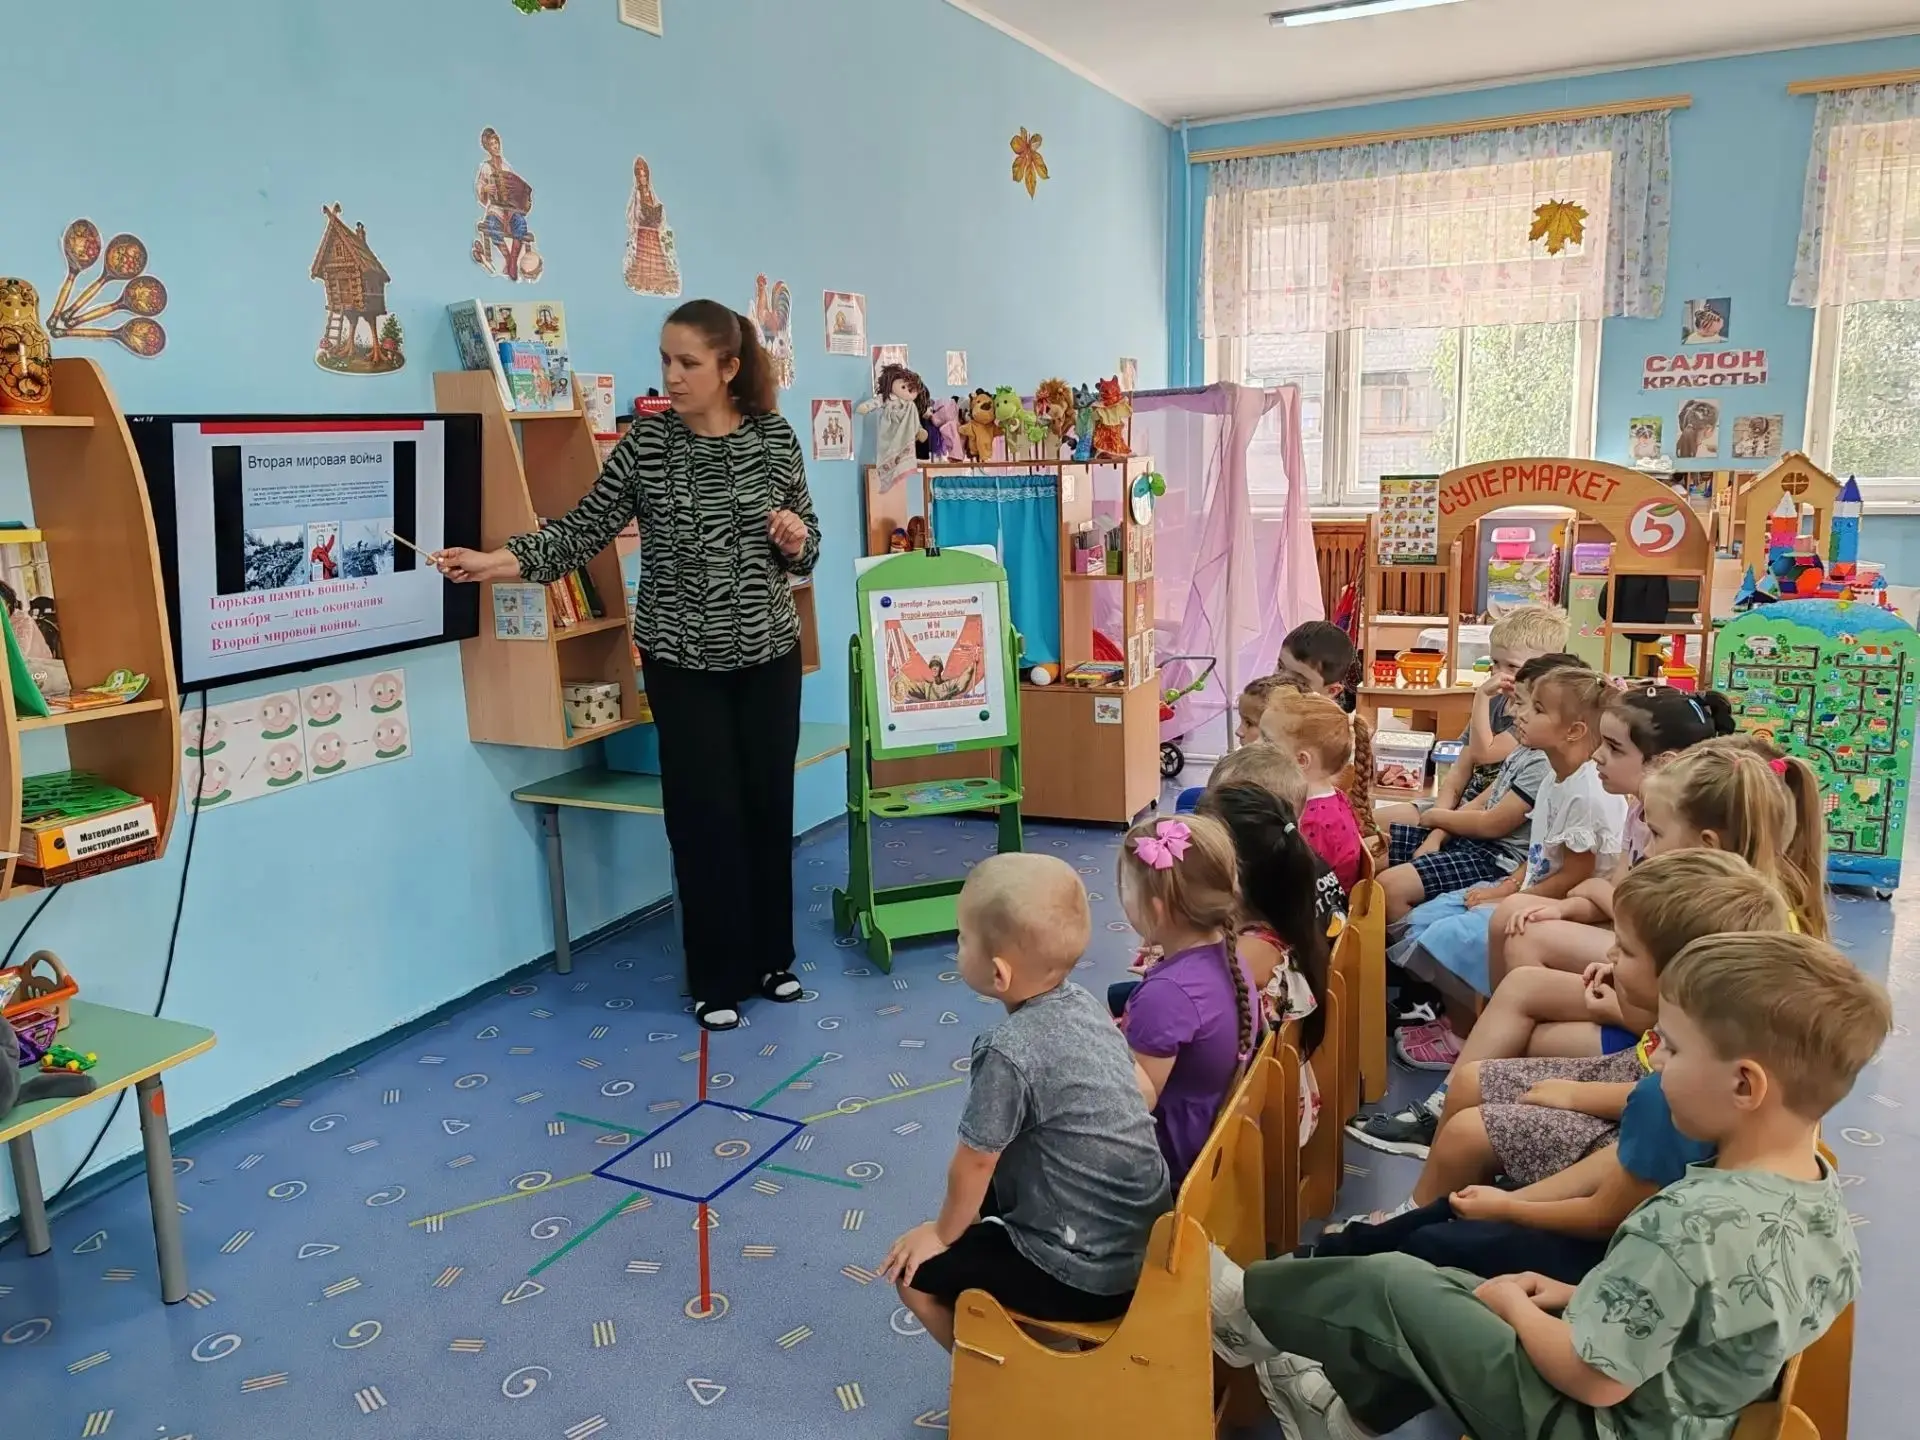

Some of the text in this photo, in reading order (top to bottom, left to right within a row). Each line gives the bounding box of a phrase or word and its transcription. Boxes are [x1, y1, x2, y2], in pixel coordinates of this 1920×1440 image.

[1645, 350, 1765, 373] САЛОН
[1643, 371, 1767, 389] КРАСОТЫ
[248, 453, 383, 471] Вторая мировая война
[1439, 464, 1621, 515] СУПЕРМАРКЕТ
[1640, 516, 1675, 550] 5
[209, 578, 369, 611] Горькая память войны. 3
[210, 612, 271, 631] сентября
[291, 605, 320, 619] день
[322, 596, 384, 613] окончания
[927, 620, 941, 629] МЫ
[211, 619, 361, 651] Второй мировой войны.
[912, 629, 959, 642] ПОБЕДИЛИ!
[77, 829, 150, 855] конструирования
[80, 820, 139, 843] Материал для
